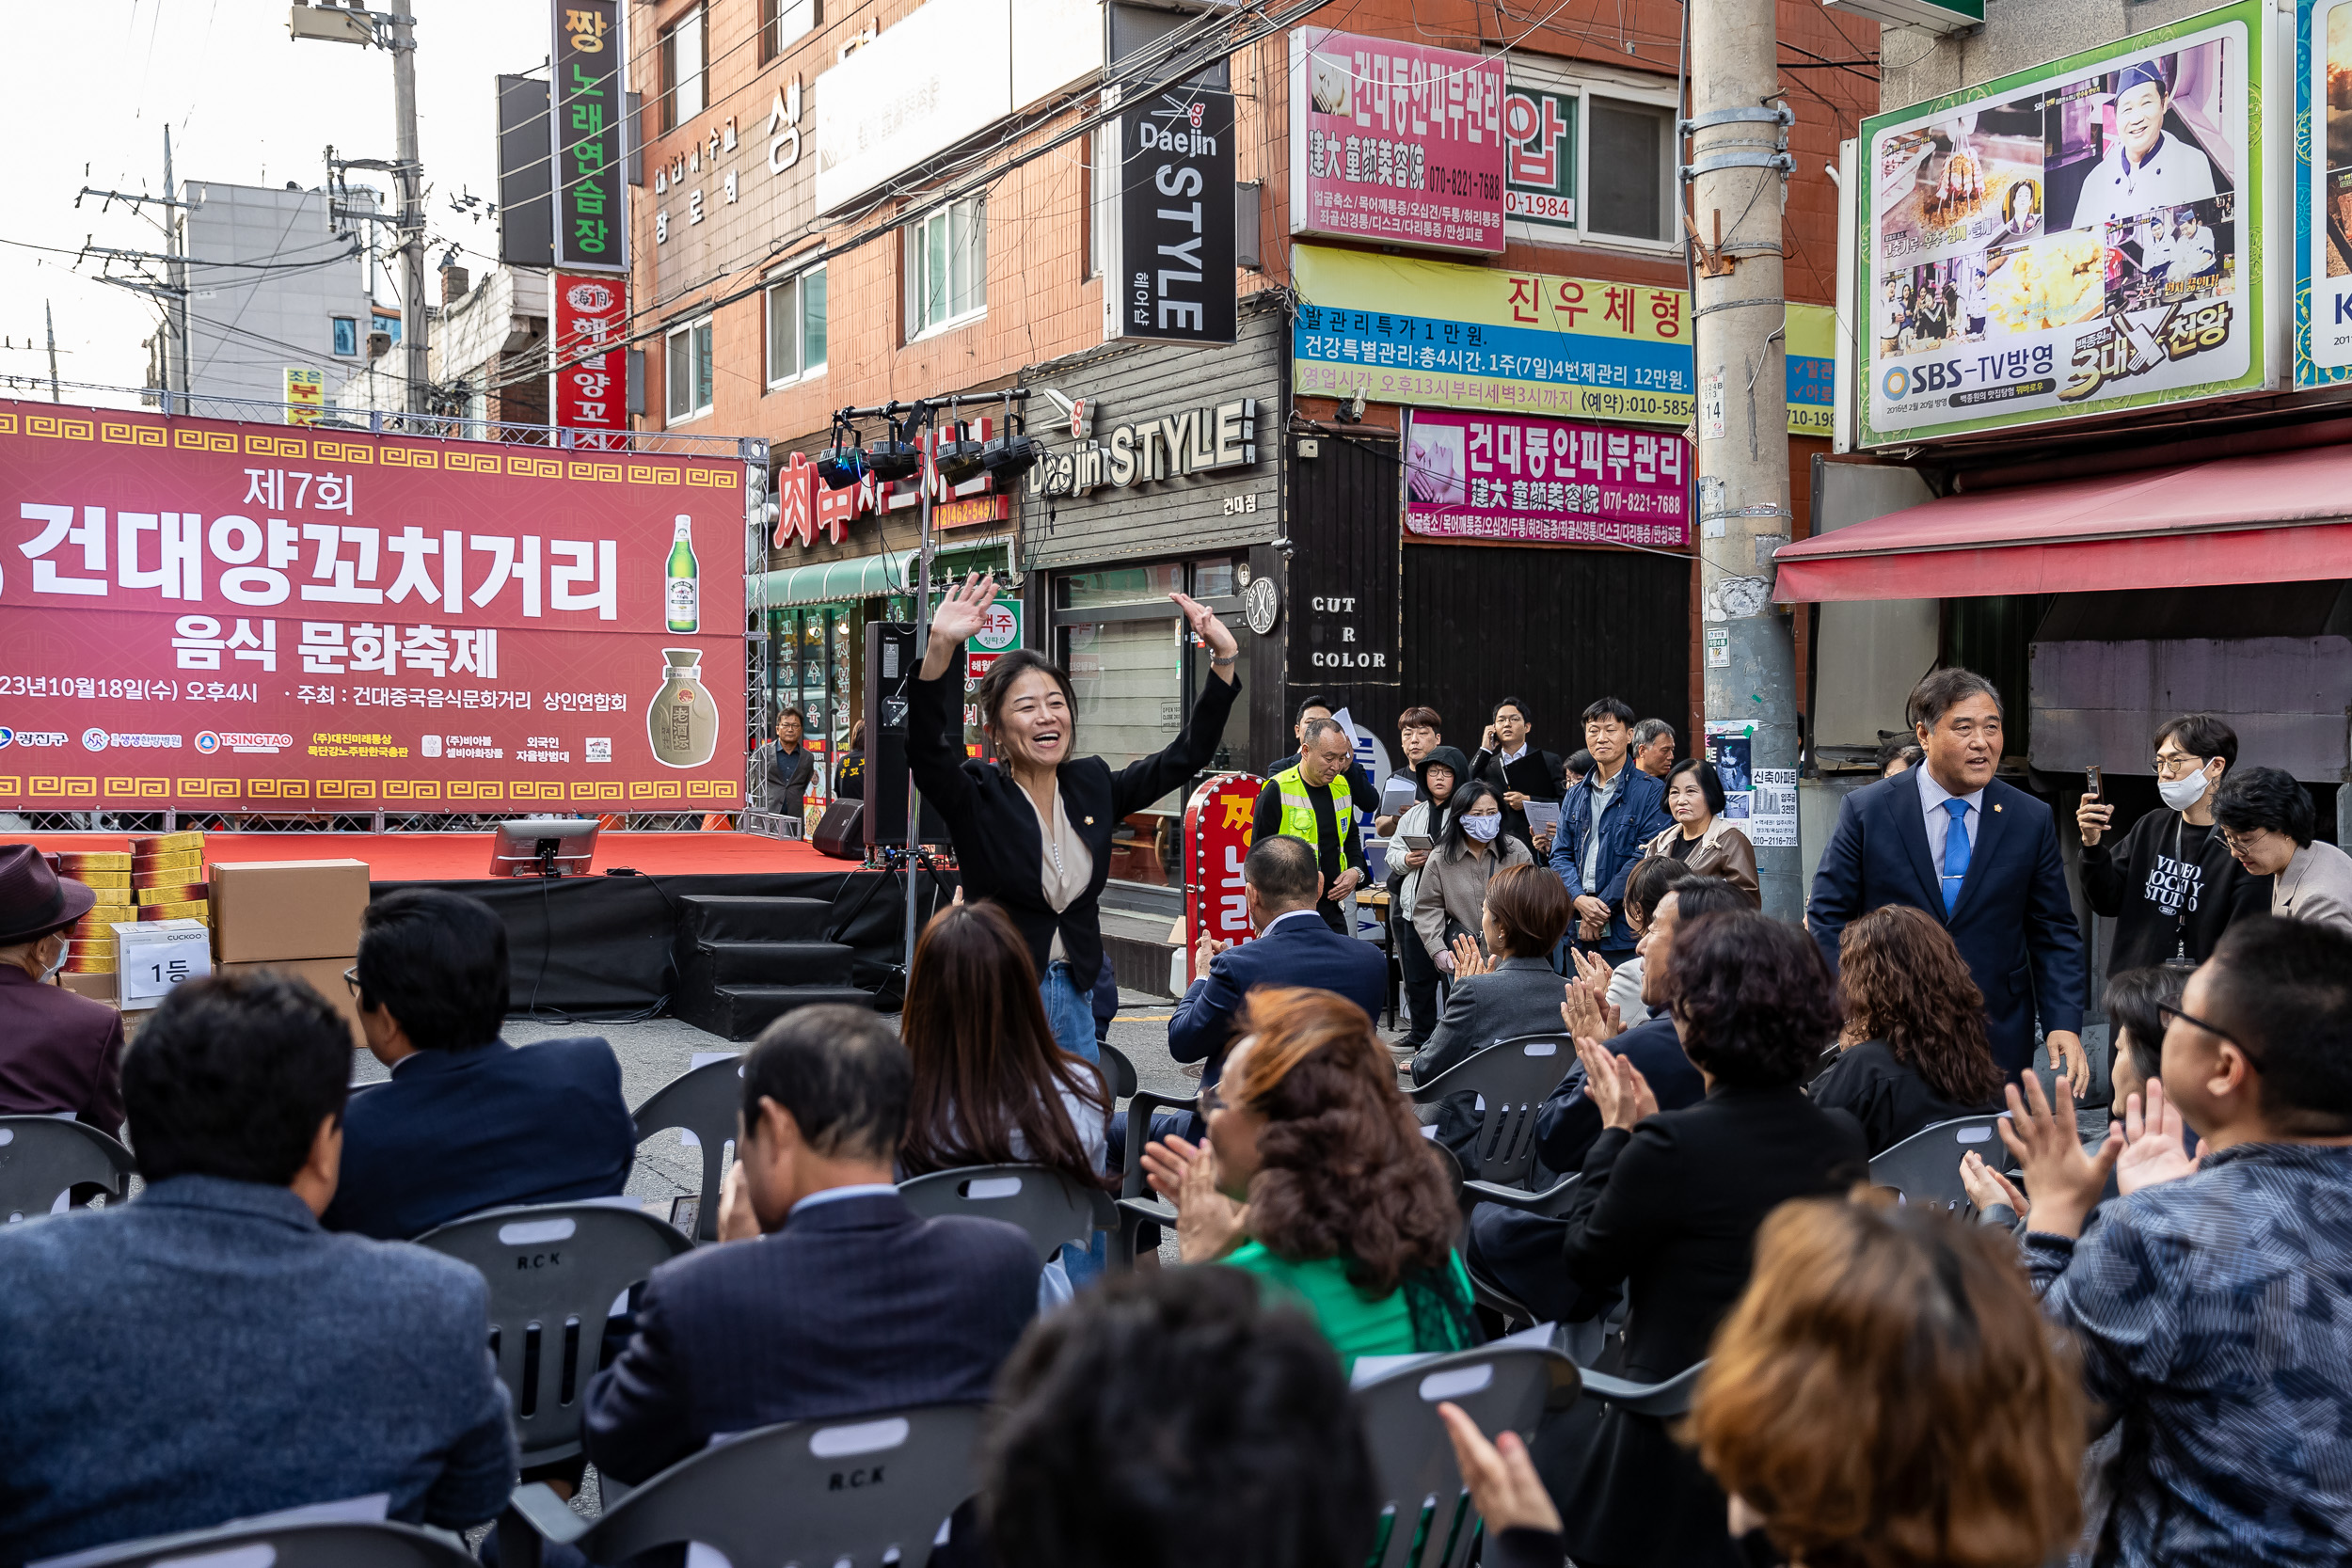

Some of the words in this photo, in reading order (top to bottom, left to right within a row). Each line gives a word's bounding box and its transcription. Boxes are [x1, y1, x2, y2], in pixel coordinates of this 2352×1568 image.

[564, 8, 608, 54] 짱
[1354, 51, 1501, 149] 건대동안피부관리
[1140, 121, 1216, 158] Daejin
[1309, 129, 1342, 179] 建大
[570, 63, 608, 254] 노래연습장
[1429, 165, 1501, 202] 070-8221-7688
[1155, 164, 1203, 331] STYLE
[1507, 277, 1681, 339] 진우체형
[1303, 366, 1374, 392] 영업시간
[1110, 398, 1255, 488] STYLE
[1469, 421, 1682, 485] 건대동안피부관리
[243, 467, 354, 516] 제7회
[1223, 493, 1257, 515] 건대점
[1470, 477, 1507, 510] 建大
[1603, 490, 1680, 515] 070-8221-7688
[18, 501, 618, 621] 건대양꼬치거리
[1311, 596, 1356, 612] CUT
[171, 614, 278, 673] 음식
[297, 620, 498, 679] 문화축제
[1343, 627, 1356, 641] R
[1311, 652, 1387, 668] COLOR
[184, 681, 258, 704] 오후4시
[296, 685, 336, 705] 주최
[352, 686, 532, 710] 건대중국음식문화거리
[543, 691, 628, 712] 상인연합회
[16, 732, 69, 746] 광진구
[220, 734, 293, 747] TSINGTAO
[526, 736, 560, 749] 외국인
[1754, 770, 1796, 784] 신축아파트
[151, 959, 190, 984] 1등
